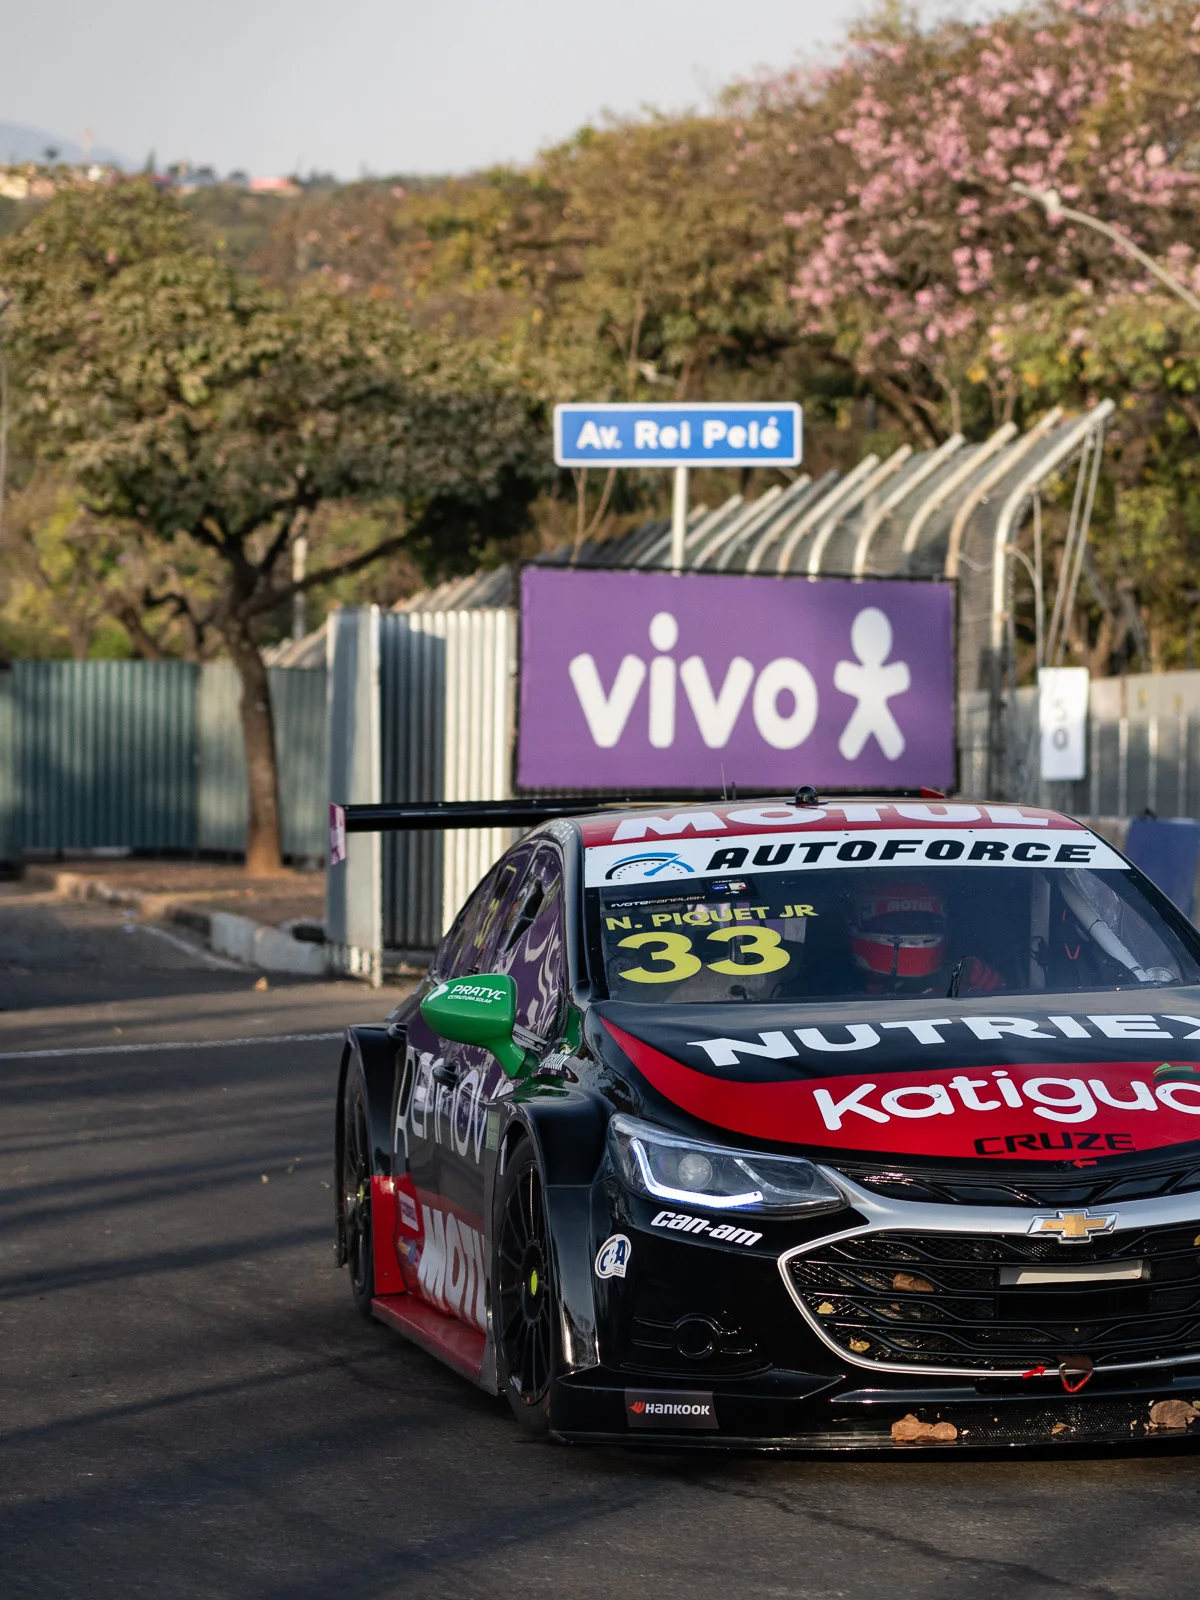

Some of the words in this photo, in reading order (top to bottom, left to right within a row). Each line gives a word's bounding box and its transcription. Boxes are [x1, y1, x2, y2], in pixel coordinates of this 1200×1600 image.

[576, 419, 623, 450] Av.
[634, 419, 691, 450] Rei
[702, 416, 781, 450] Pelé
[568, 612, 819, 749] vivo
[611, 803, 1050, 842] MOTUL
[704, 838, 1097, 871] AUTOFORCE
[605, 916, 643, 931] N.
[652, 906, 769, 927] PIQUET
[779, 904, 819, 918] JR
[886, 900, 934, 912] MOTUL
[617, 925, 791, 984] 33
[450, 984, 507, 1000] PRATYC
[974, 1132, 1137, 1157] CRUZE
[650, 1210, 764, 1246] can-am
